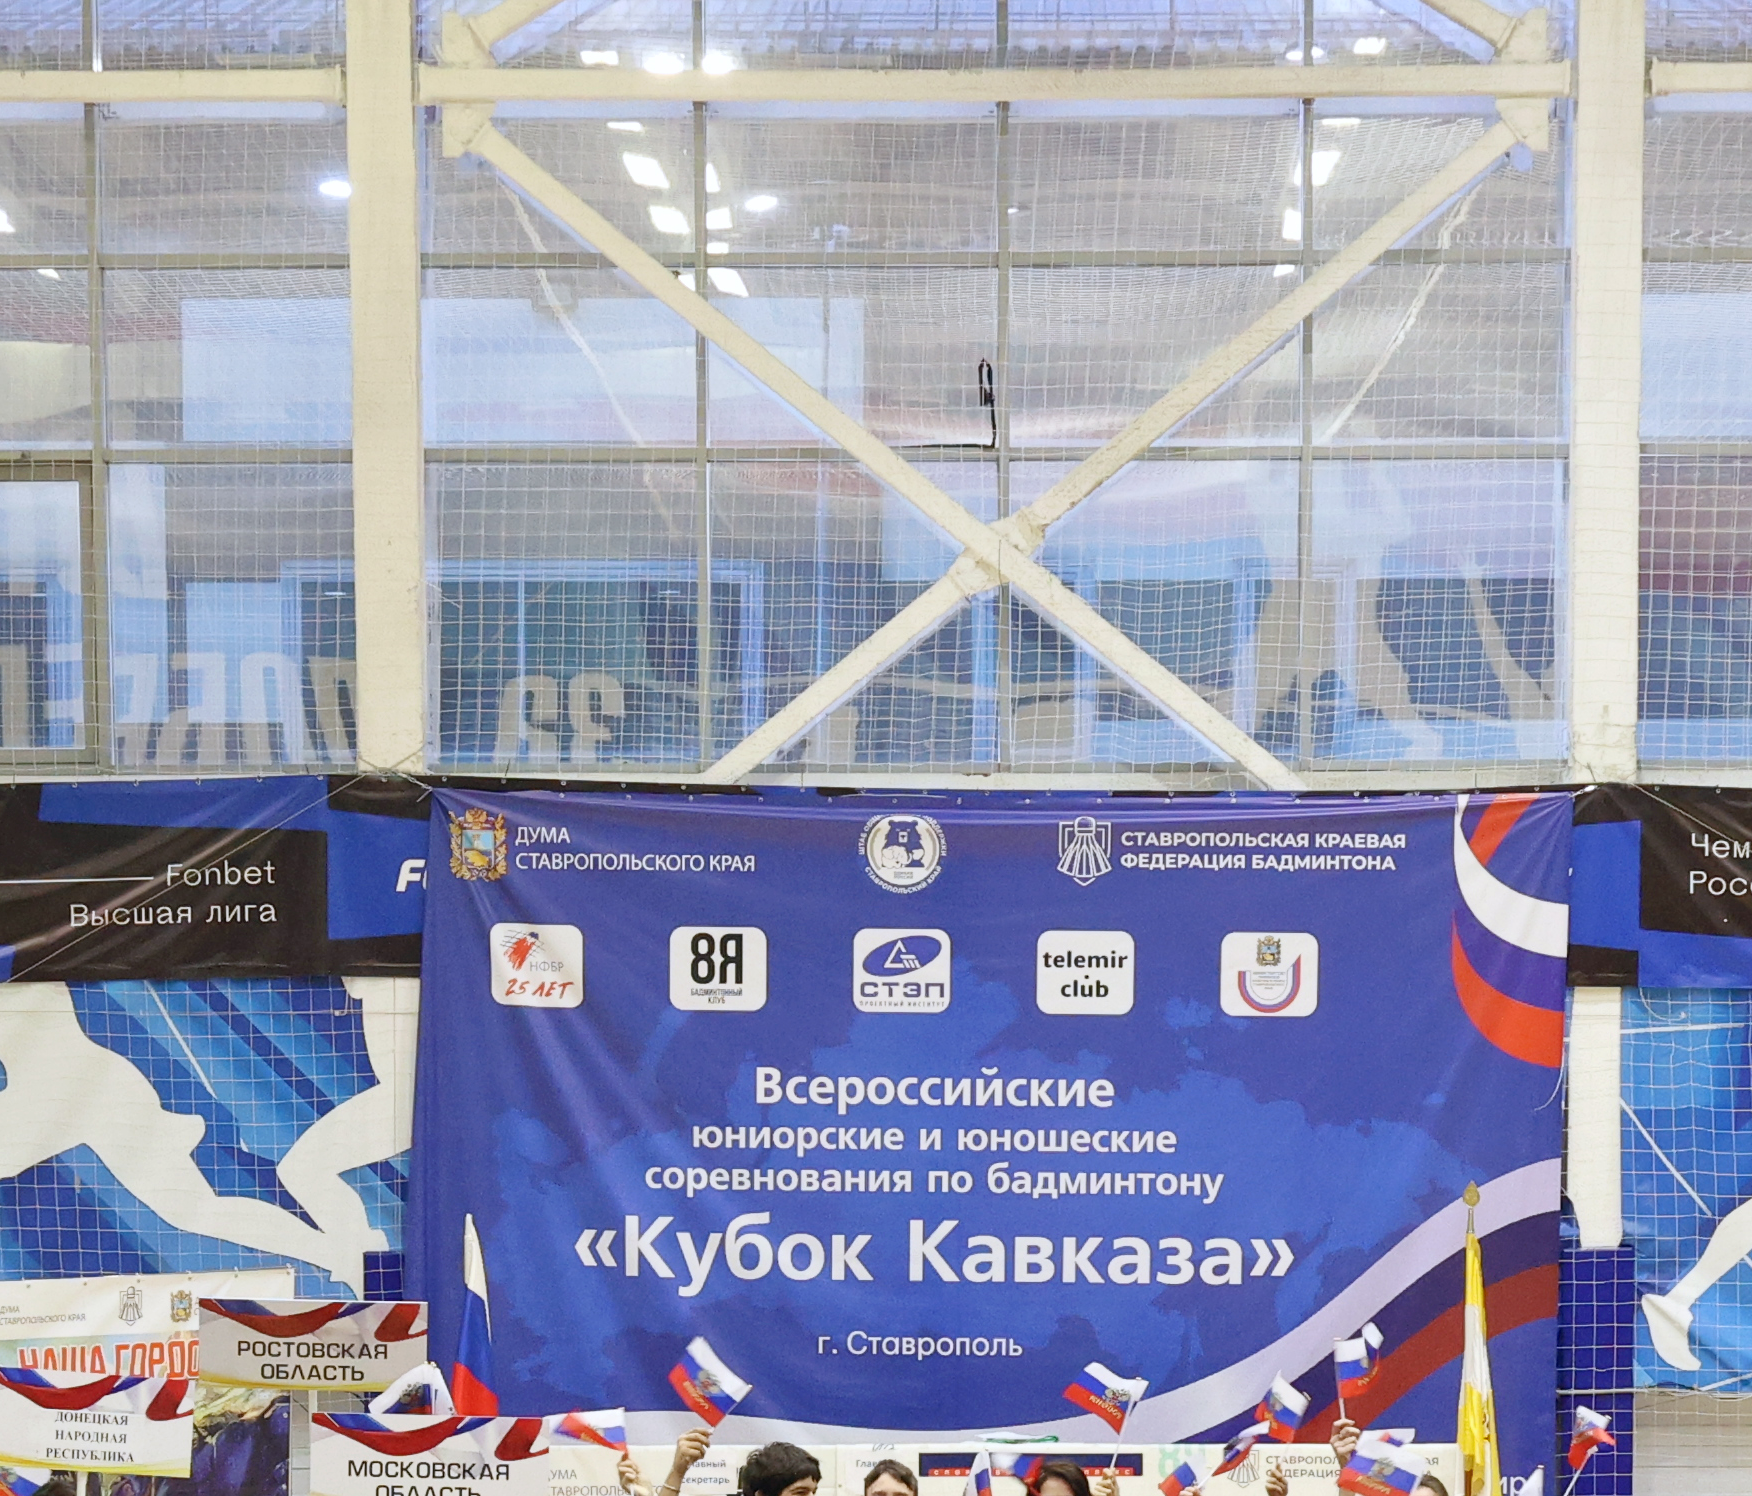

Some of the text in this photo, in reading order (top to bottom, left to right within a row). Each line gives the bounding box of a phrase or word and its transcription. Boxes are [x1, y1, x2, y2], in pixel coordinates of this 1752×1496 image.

[515, 827, 571, 846] ДУМА
[1121, 832, 1407, 849] СТАВРОПОЛЬСКАЯ КРАЕВАЯ
[515, 853, 756, 873] СТАВРОПОЛЬСКОГО КРАЯ
[1120, 853, 1396, 871] ФЕДЕРАЦИЯ БАДМИНТОНА
[165, 859, 275, 888] Fonbet
[69, 899, 277, 928] Высшая лига
[530, 961, 564, 973] НФБР
[690, 932, 743, 985] 8Я
[1043, 950, 1128, 968] telemir
[504, 978, 574, 998] 25 ЛЕТ
[860, 982, 945, 998] СТЭП
[1061, 981, 1109, 998] club
[754, 1066, 1115, 1113] Всероссийские
[692, 1123, 1178, 1160] юниорские и юношеские
[644, 1161, 1224, 1205] соревнования по бадминтону
[574, 1214, 1296, 1297] «Кубок Кавказа»
[237, 1340, 388, 1361] РОСТОВСКАЯ
[817, 1330, 1024, 1361] г. Ставрополь
[260, 1363, 365, 1382] ОБЛАСТЬ
[54, 1410, 129, 1428] ДОНЕЦКАЯ
[54, 1430, 128, 1444] НАРОДНАЯ
[46, 1447, 135, 1463] РЕСПУБЛИКА
[347, 1459, 510, 1482] МОСКОВСКАЯ
